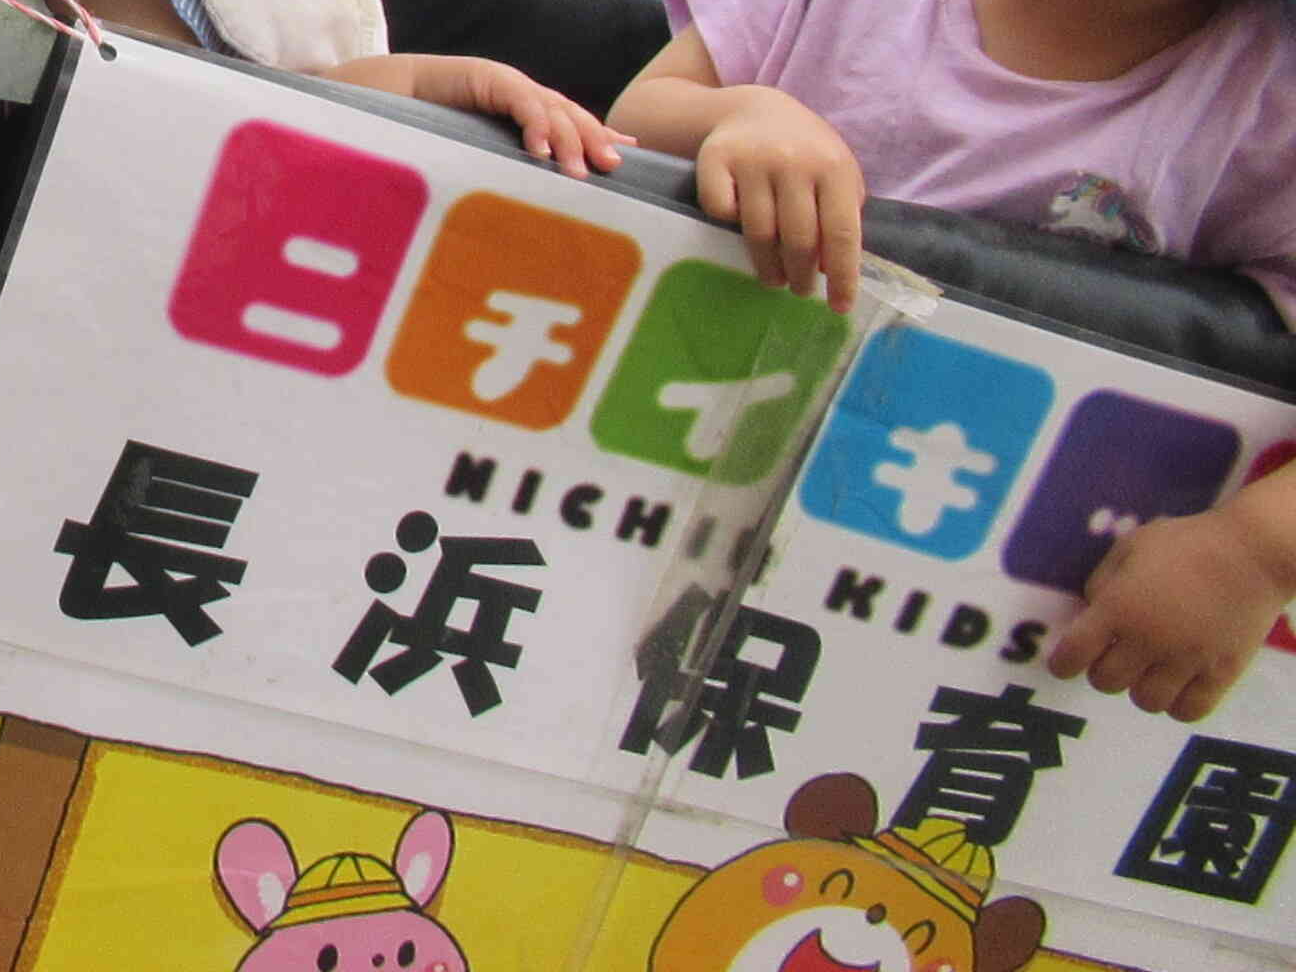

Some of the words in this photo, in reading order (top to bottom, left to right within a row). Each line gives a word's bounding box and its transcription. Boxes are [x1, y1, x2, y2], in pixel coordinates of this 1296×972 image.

[54, 438, 1296, 905] 長浜保育園
[824, 565, 1049, 666] KIDS
